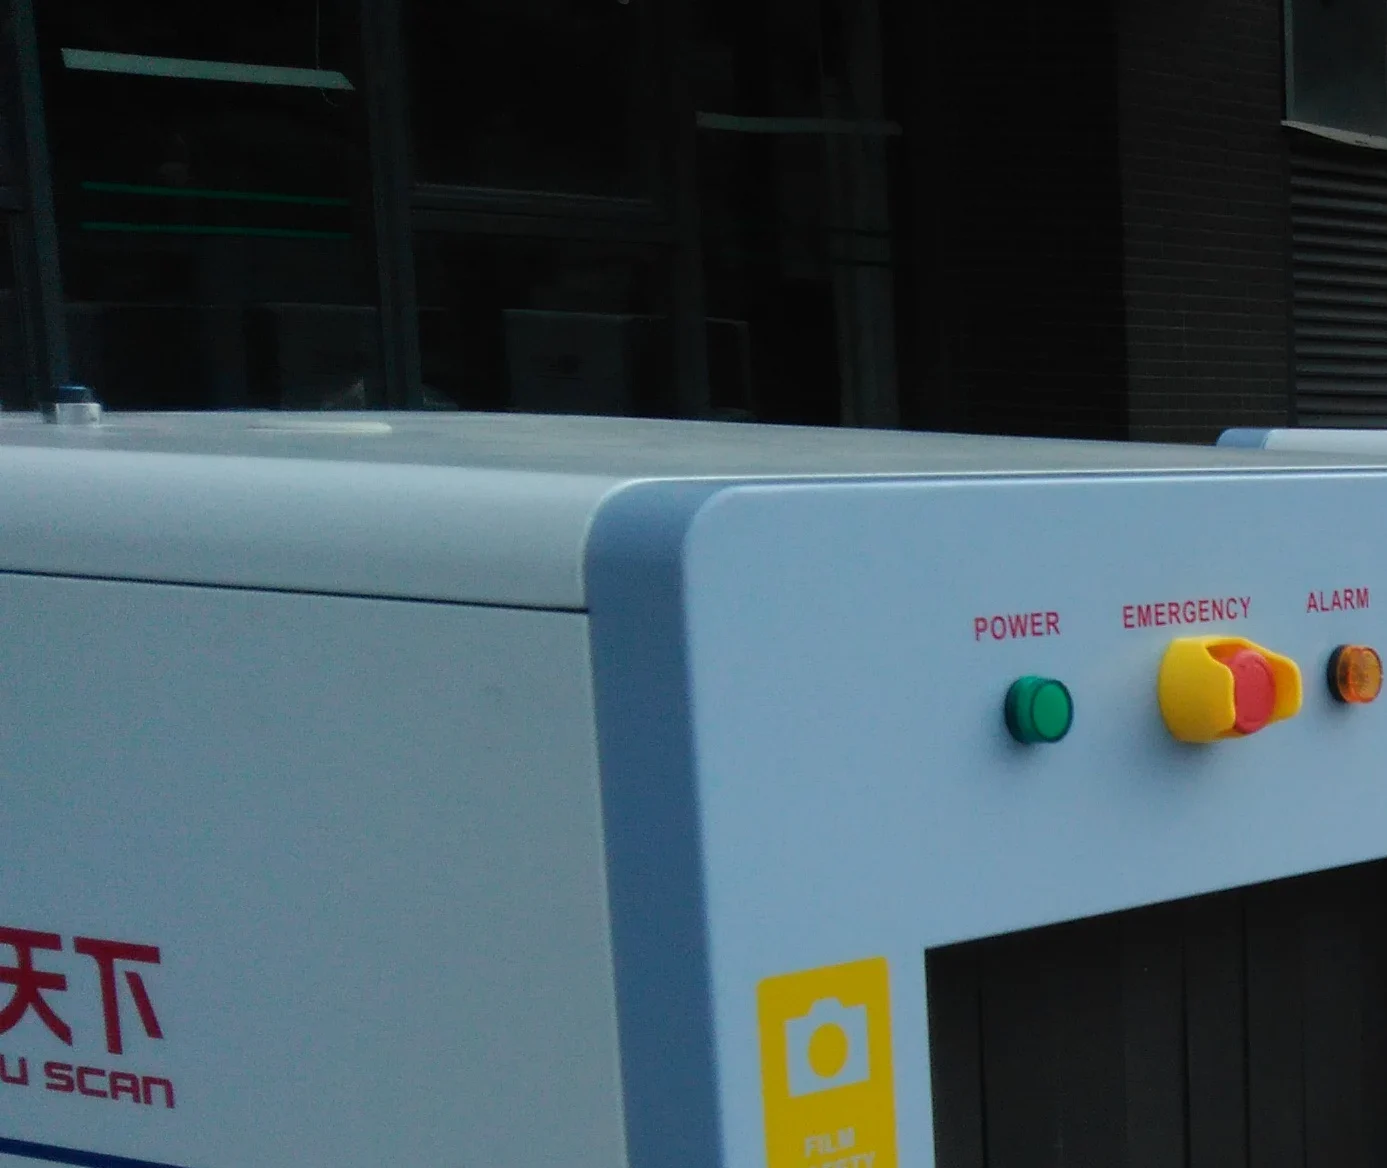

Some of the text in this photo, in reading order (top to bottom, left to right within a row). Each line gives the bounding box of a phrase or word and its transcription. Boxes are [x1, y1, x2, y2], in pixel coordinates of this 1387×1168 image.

[974, 611, 1060, 641] POWER
[1122, 597, 1251, 629] EMERGENCY
[1306, 587, 1370, 614] ALARM
[44, 1060, 176, 1109] SCAN
[803, 1126, 856, 1159] FILM
